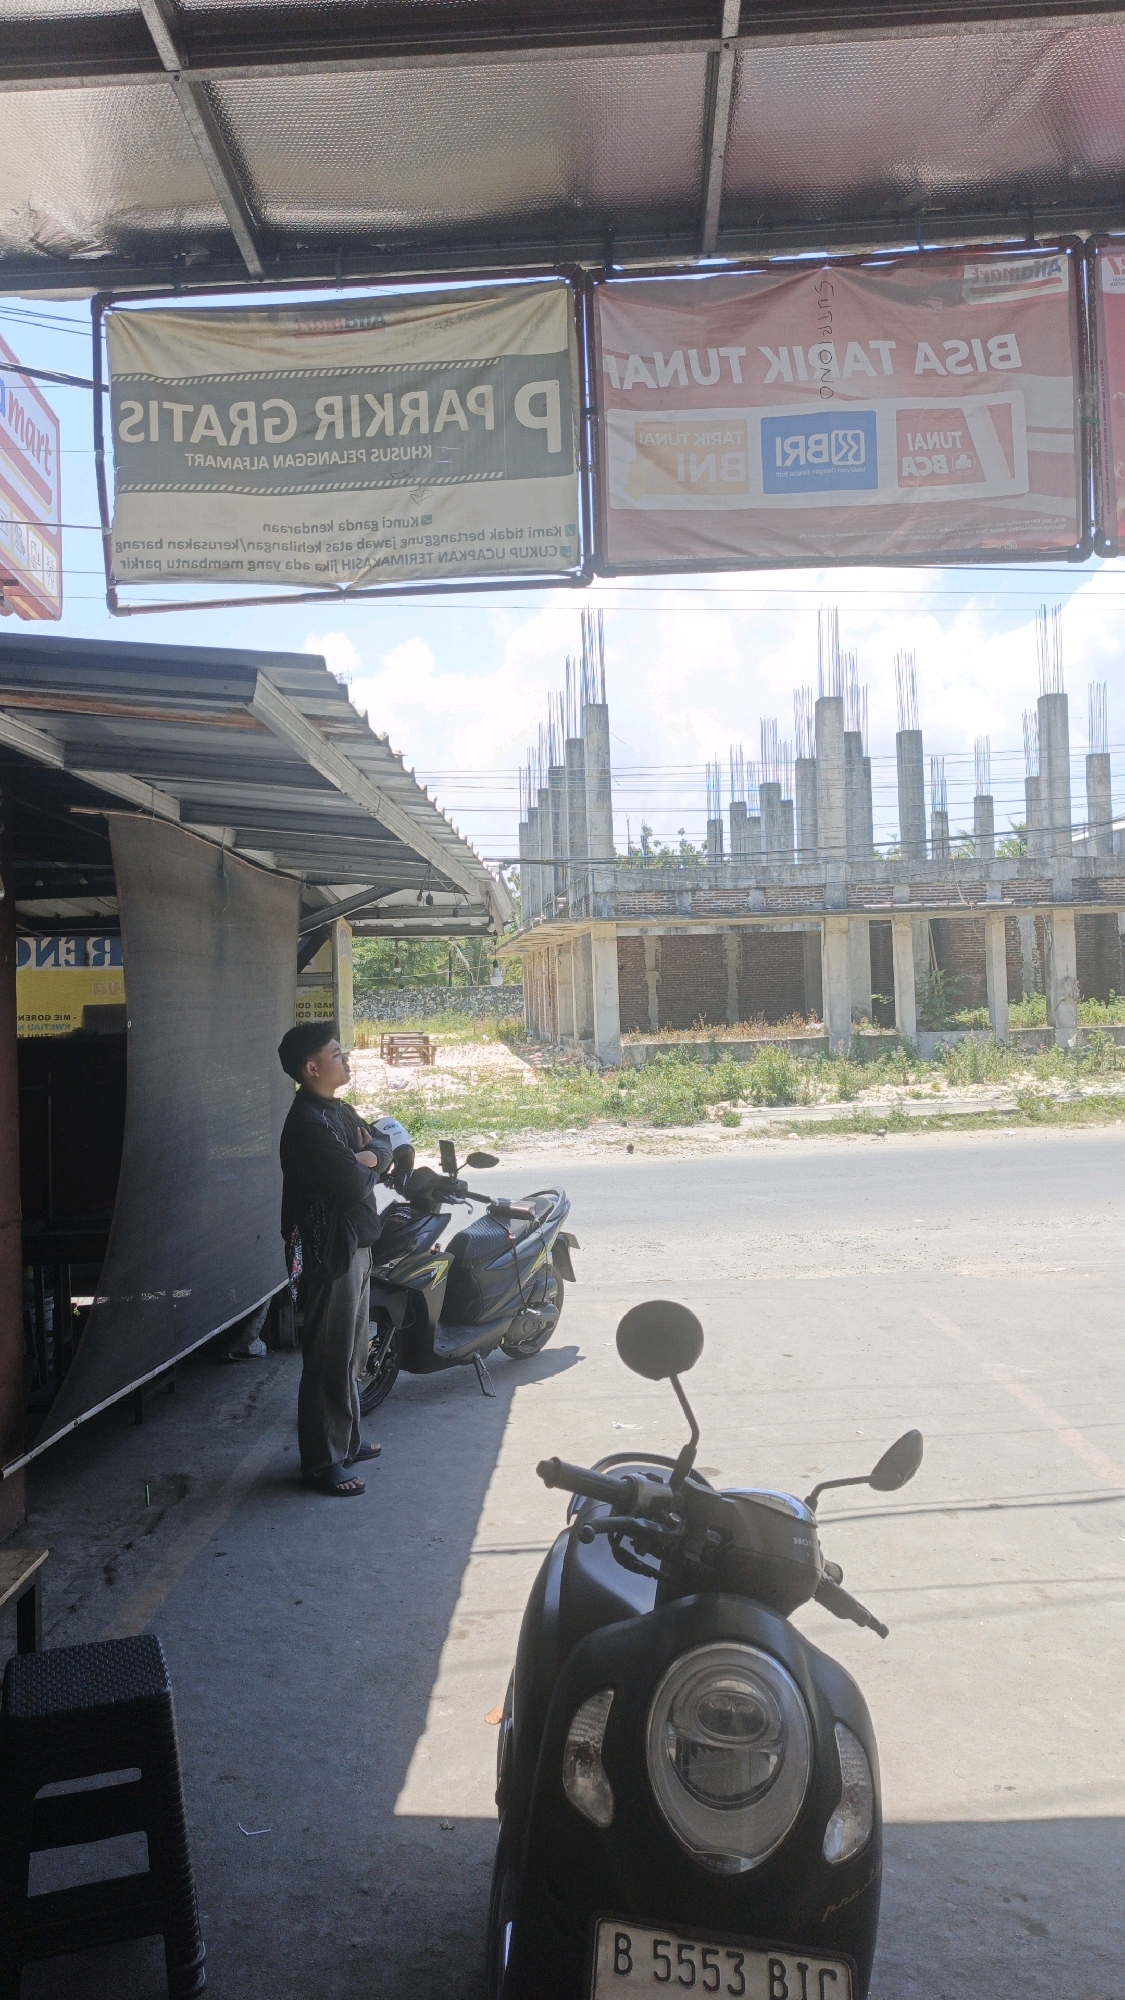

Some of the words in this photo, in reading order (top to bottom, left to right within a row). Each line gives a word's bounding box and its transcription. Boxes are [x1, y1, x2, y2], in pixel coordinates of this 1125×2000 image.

[0, 378, 52, 477] mart
[613, 1932, 633, 1975] B
[653, 1938, 746, 1996] 5553
